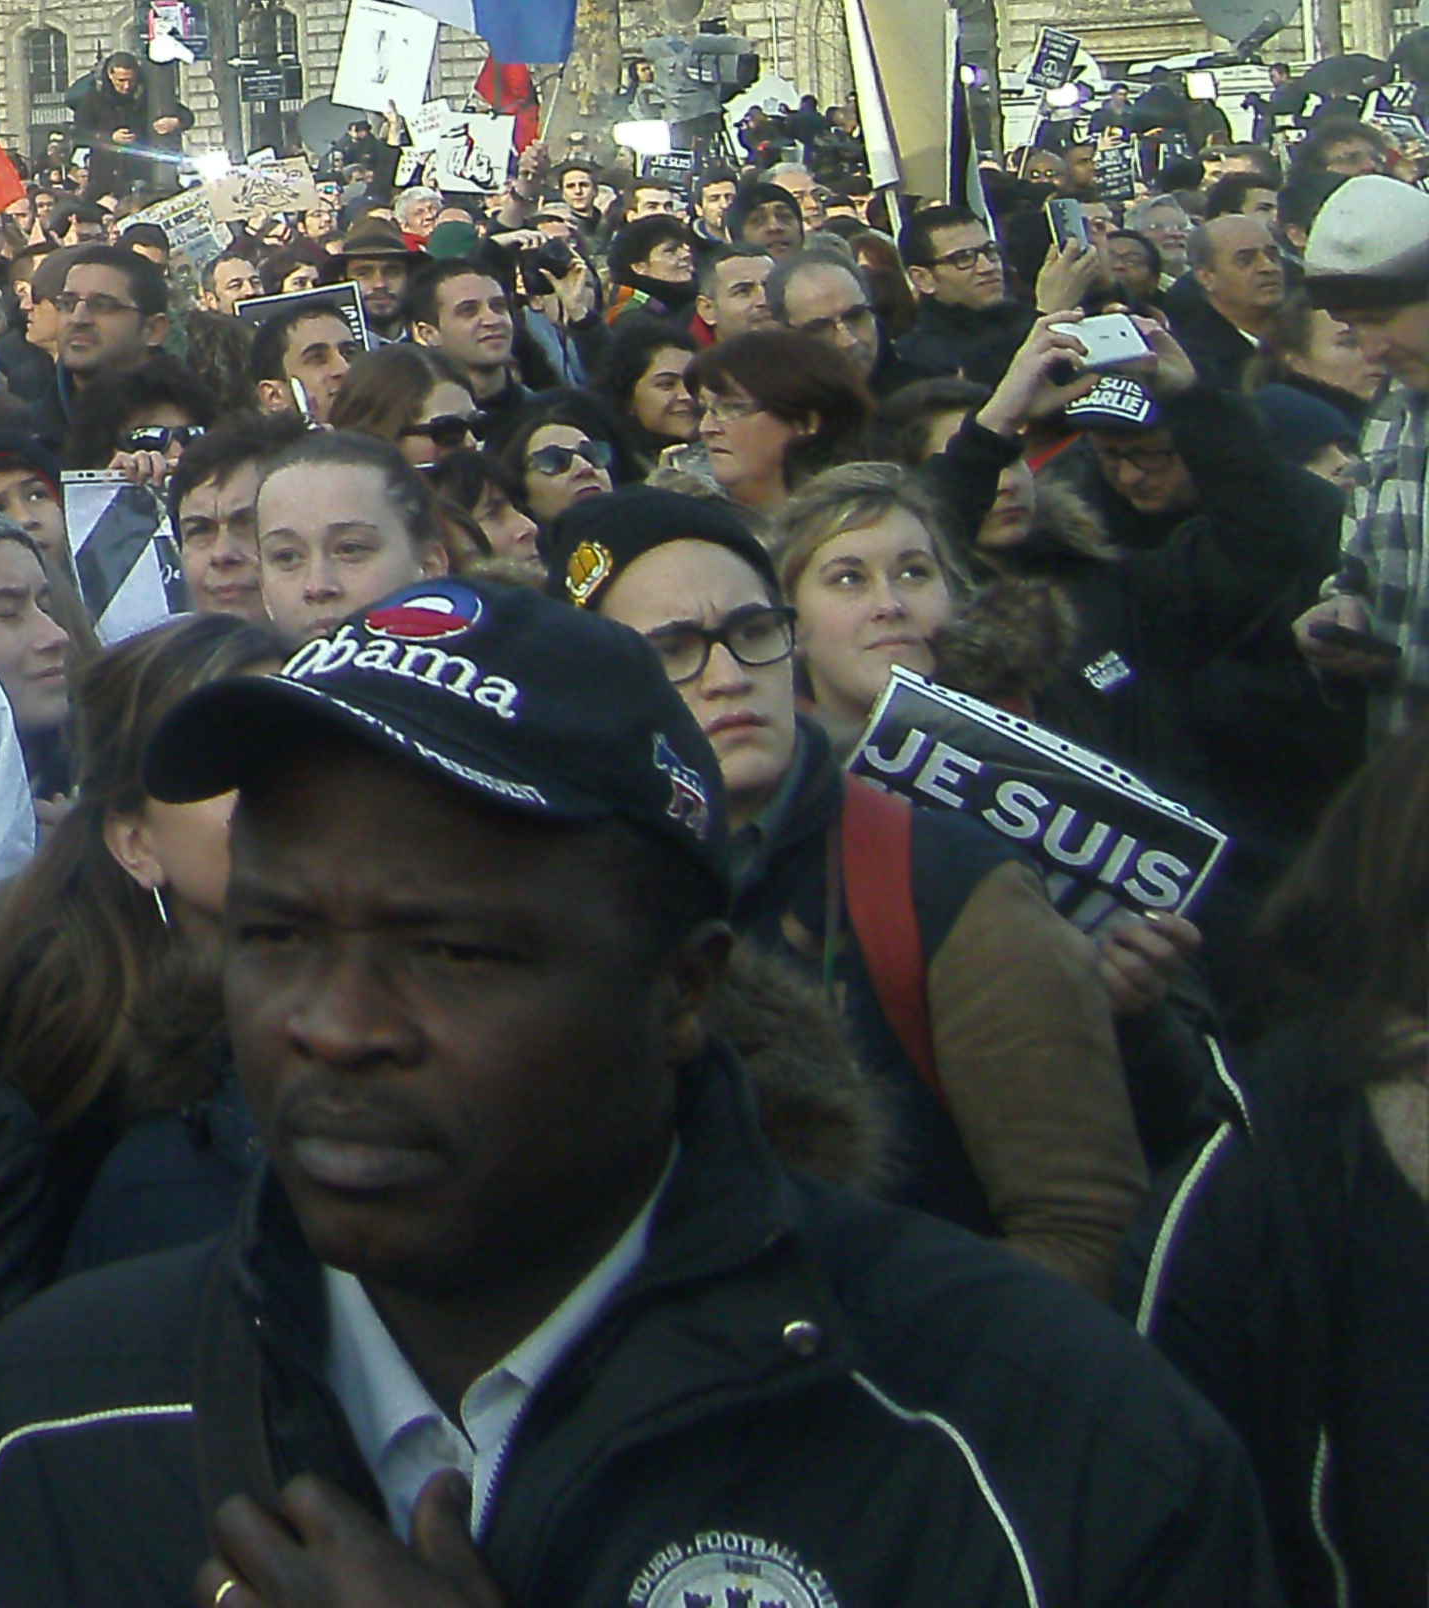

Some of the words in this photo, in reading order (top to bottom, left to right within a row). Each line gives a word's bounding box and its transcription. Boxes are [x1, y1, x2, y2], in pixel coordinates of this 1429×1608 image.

[279, 624, 520, 720] Obama
[863, 727, 984, 809] JE
[981, 780, 1192, 908] SUIS
[694, 1529, 799, 1570] FOOTBALL
